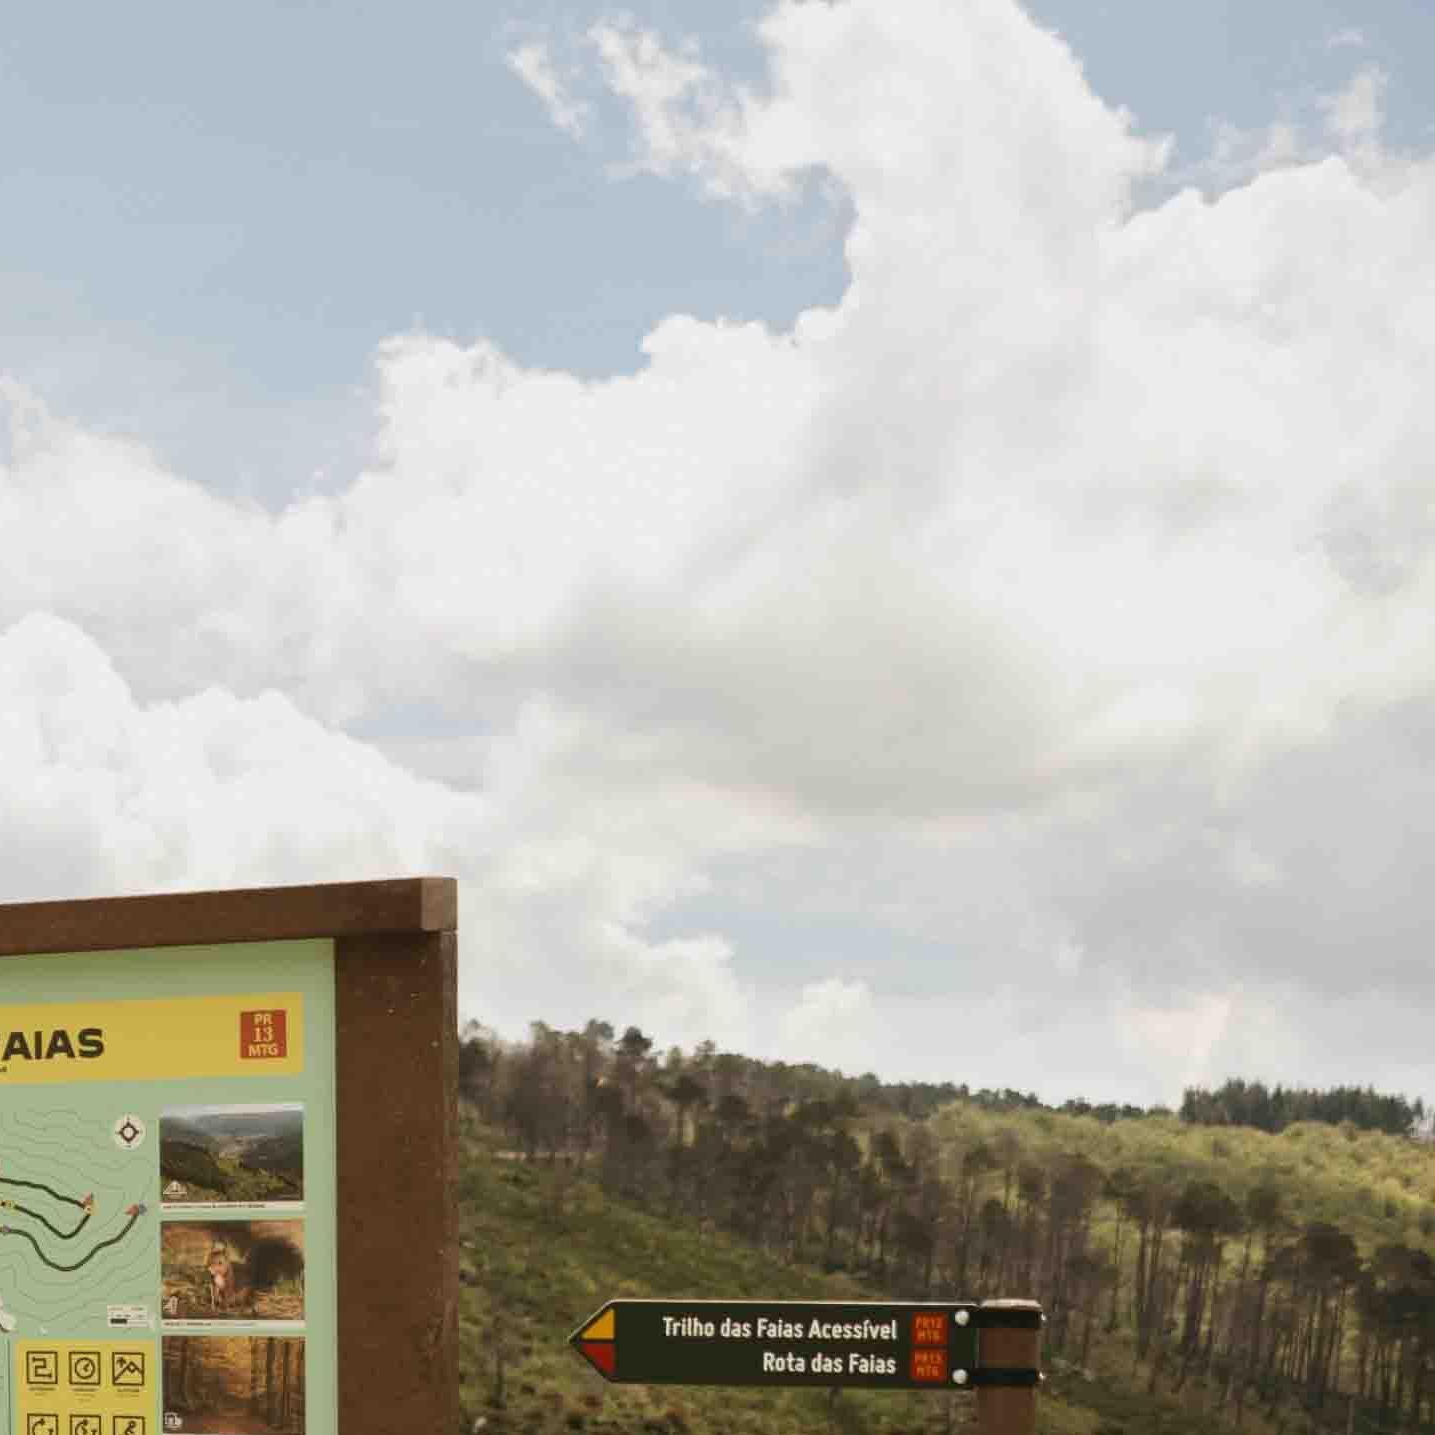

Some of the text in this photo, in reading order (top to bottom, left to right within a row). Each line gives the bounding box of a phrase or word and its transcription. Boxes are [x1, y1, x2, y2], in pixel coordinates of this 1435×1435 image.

[254, 1014, 273, 1024] PR
[253, 1027, 273, 1041] 13
[248, 1043, 279, 1057] MTG
[662, 1317, 898, 1340] Trilho das Faias Acessível
[763, 1352, 897, 1374] Rota das Faias
